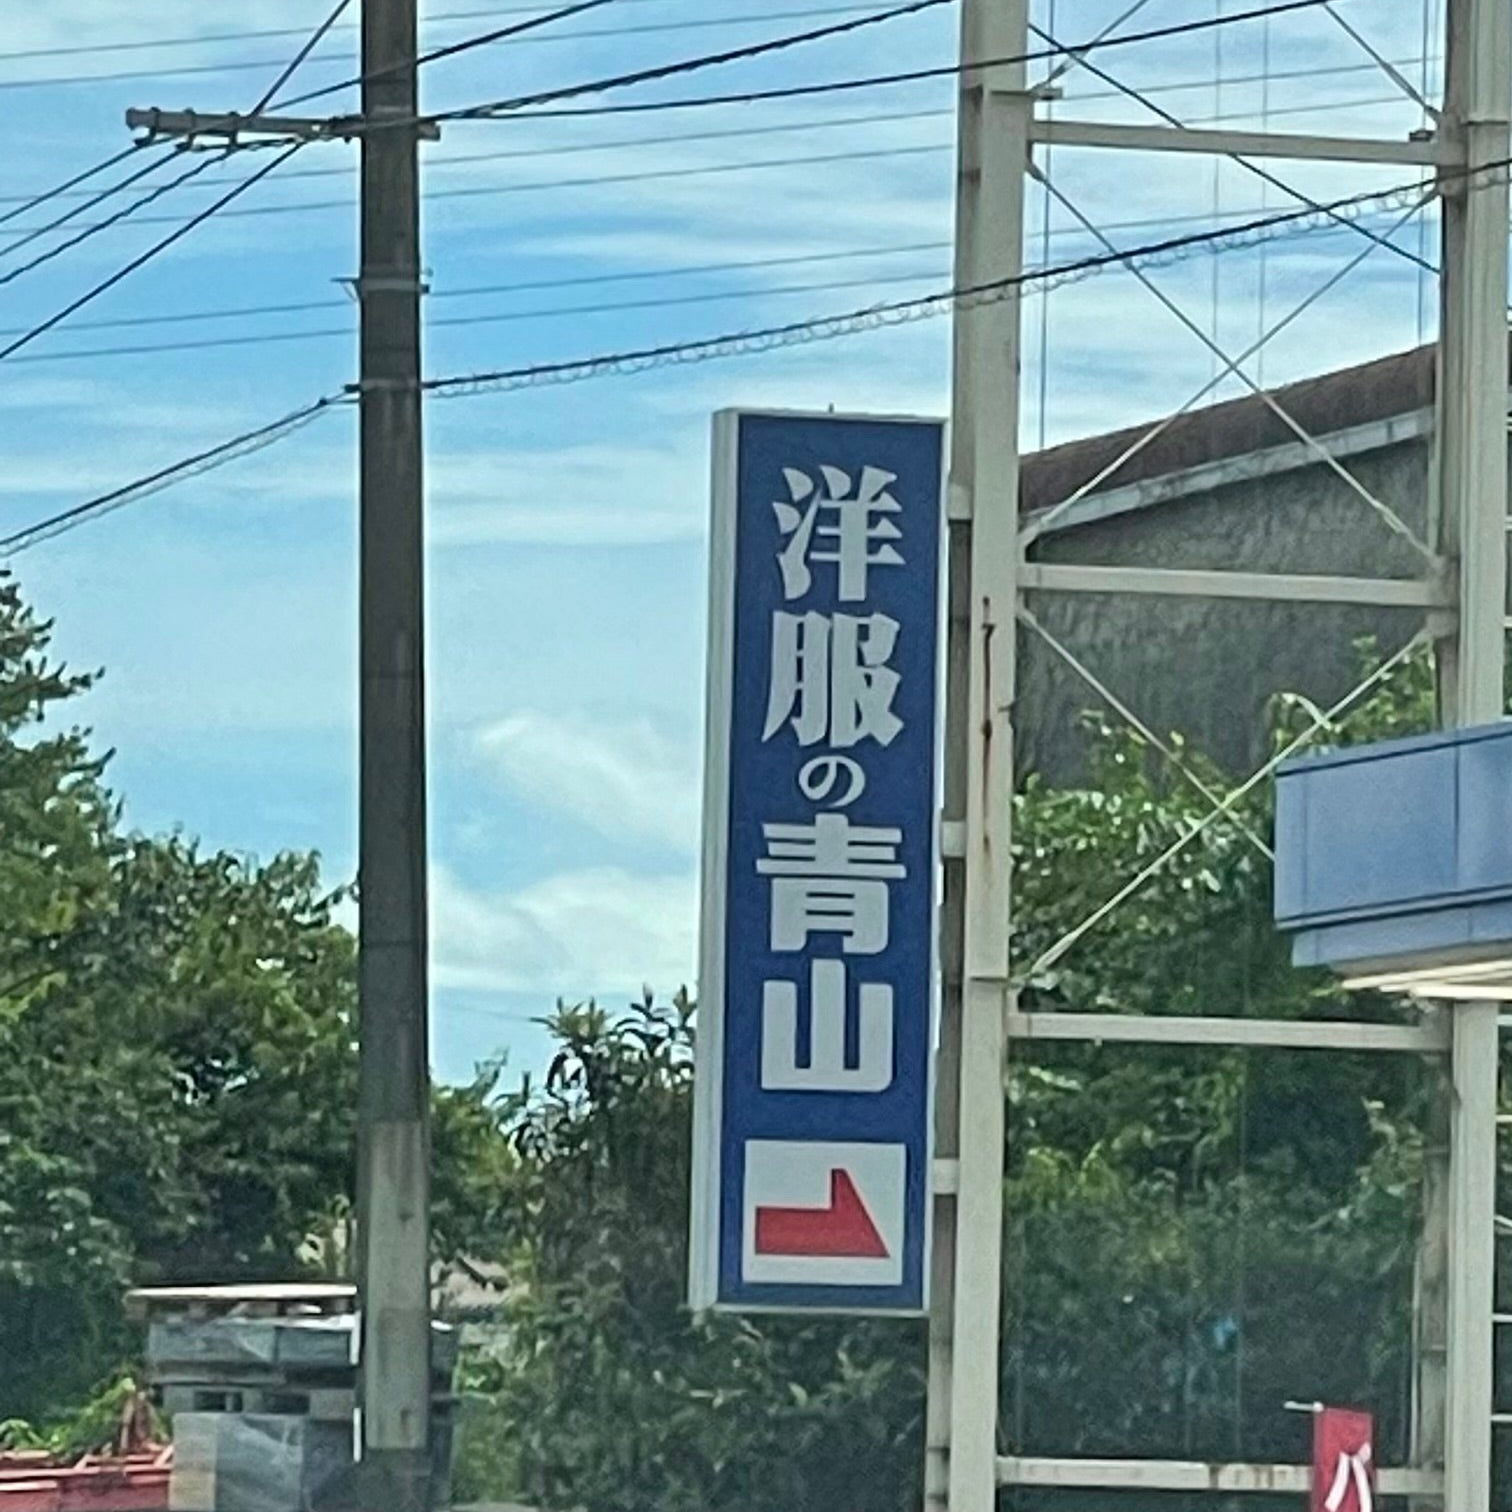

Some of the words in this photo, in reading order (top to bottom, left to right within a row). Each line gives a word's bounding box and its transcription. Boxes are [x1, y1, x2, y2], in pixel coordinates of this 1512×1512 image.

[755, 464, 908, 1094] 洋服の青山
